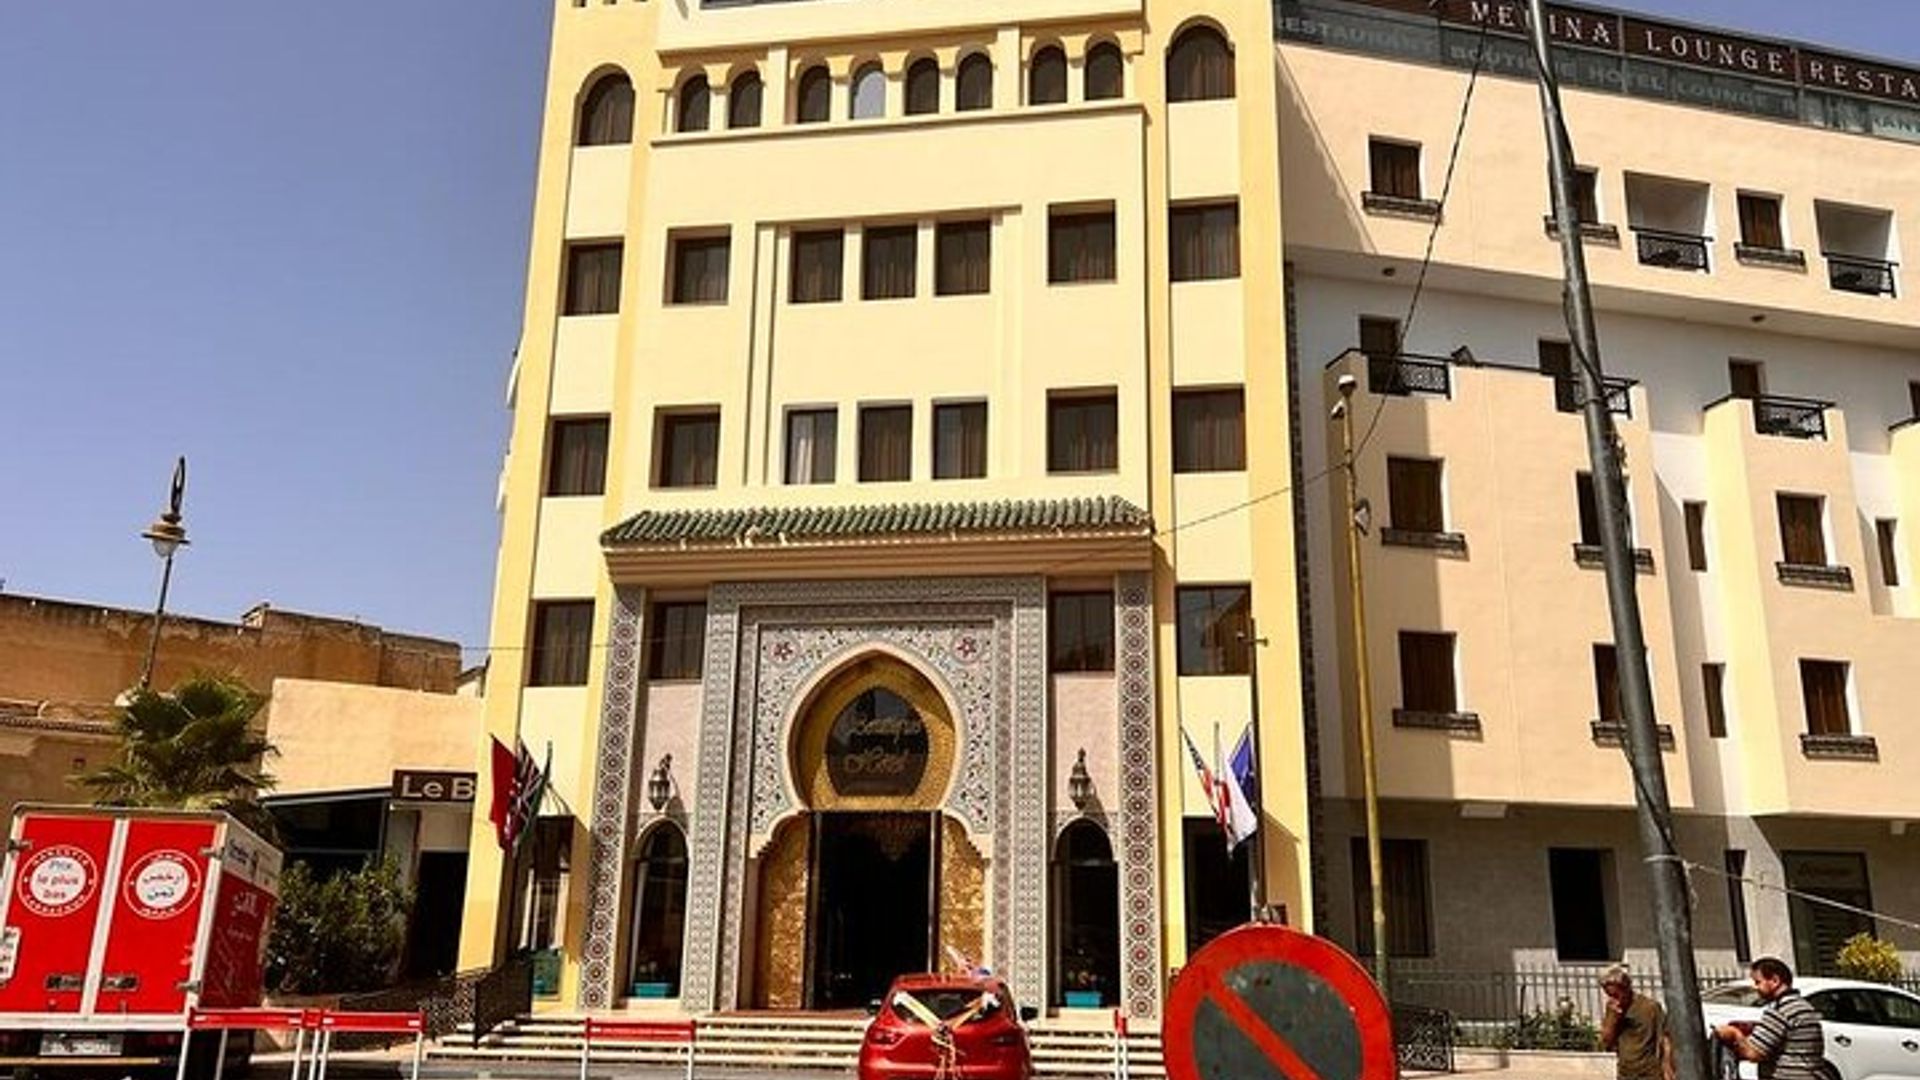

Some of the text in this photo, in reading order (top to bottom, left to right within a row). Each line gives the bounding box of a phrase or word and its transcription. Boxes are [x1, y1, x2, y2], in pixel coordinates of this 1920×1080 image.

[1470, 1, 1919, 99] MEINA LOUNGE RESTA
[401, 775, 475, 799] Le B
[51, 875, 79, 886] plus
